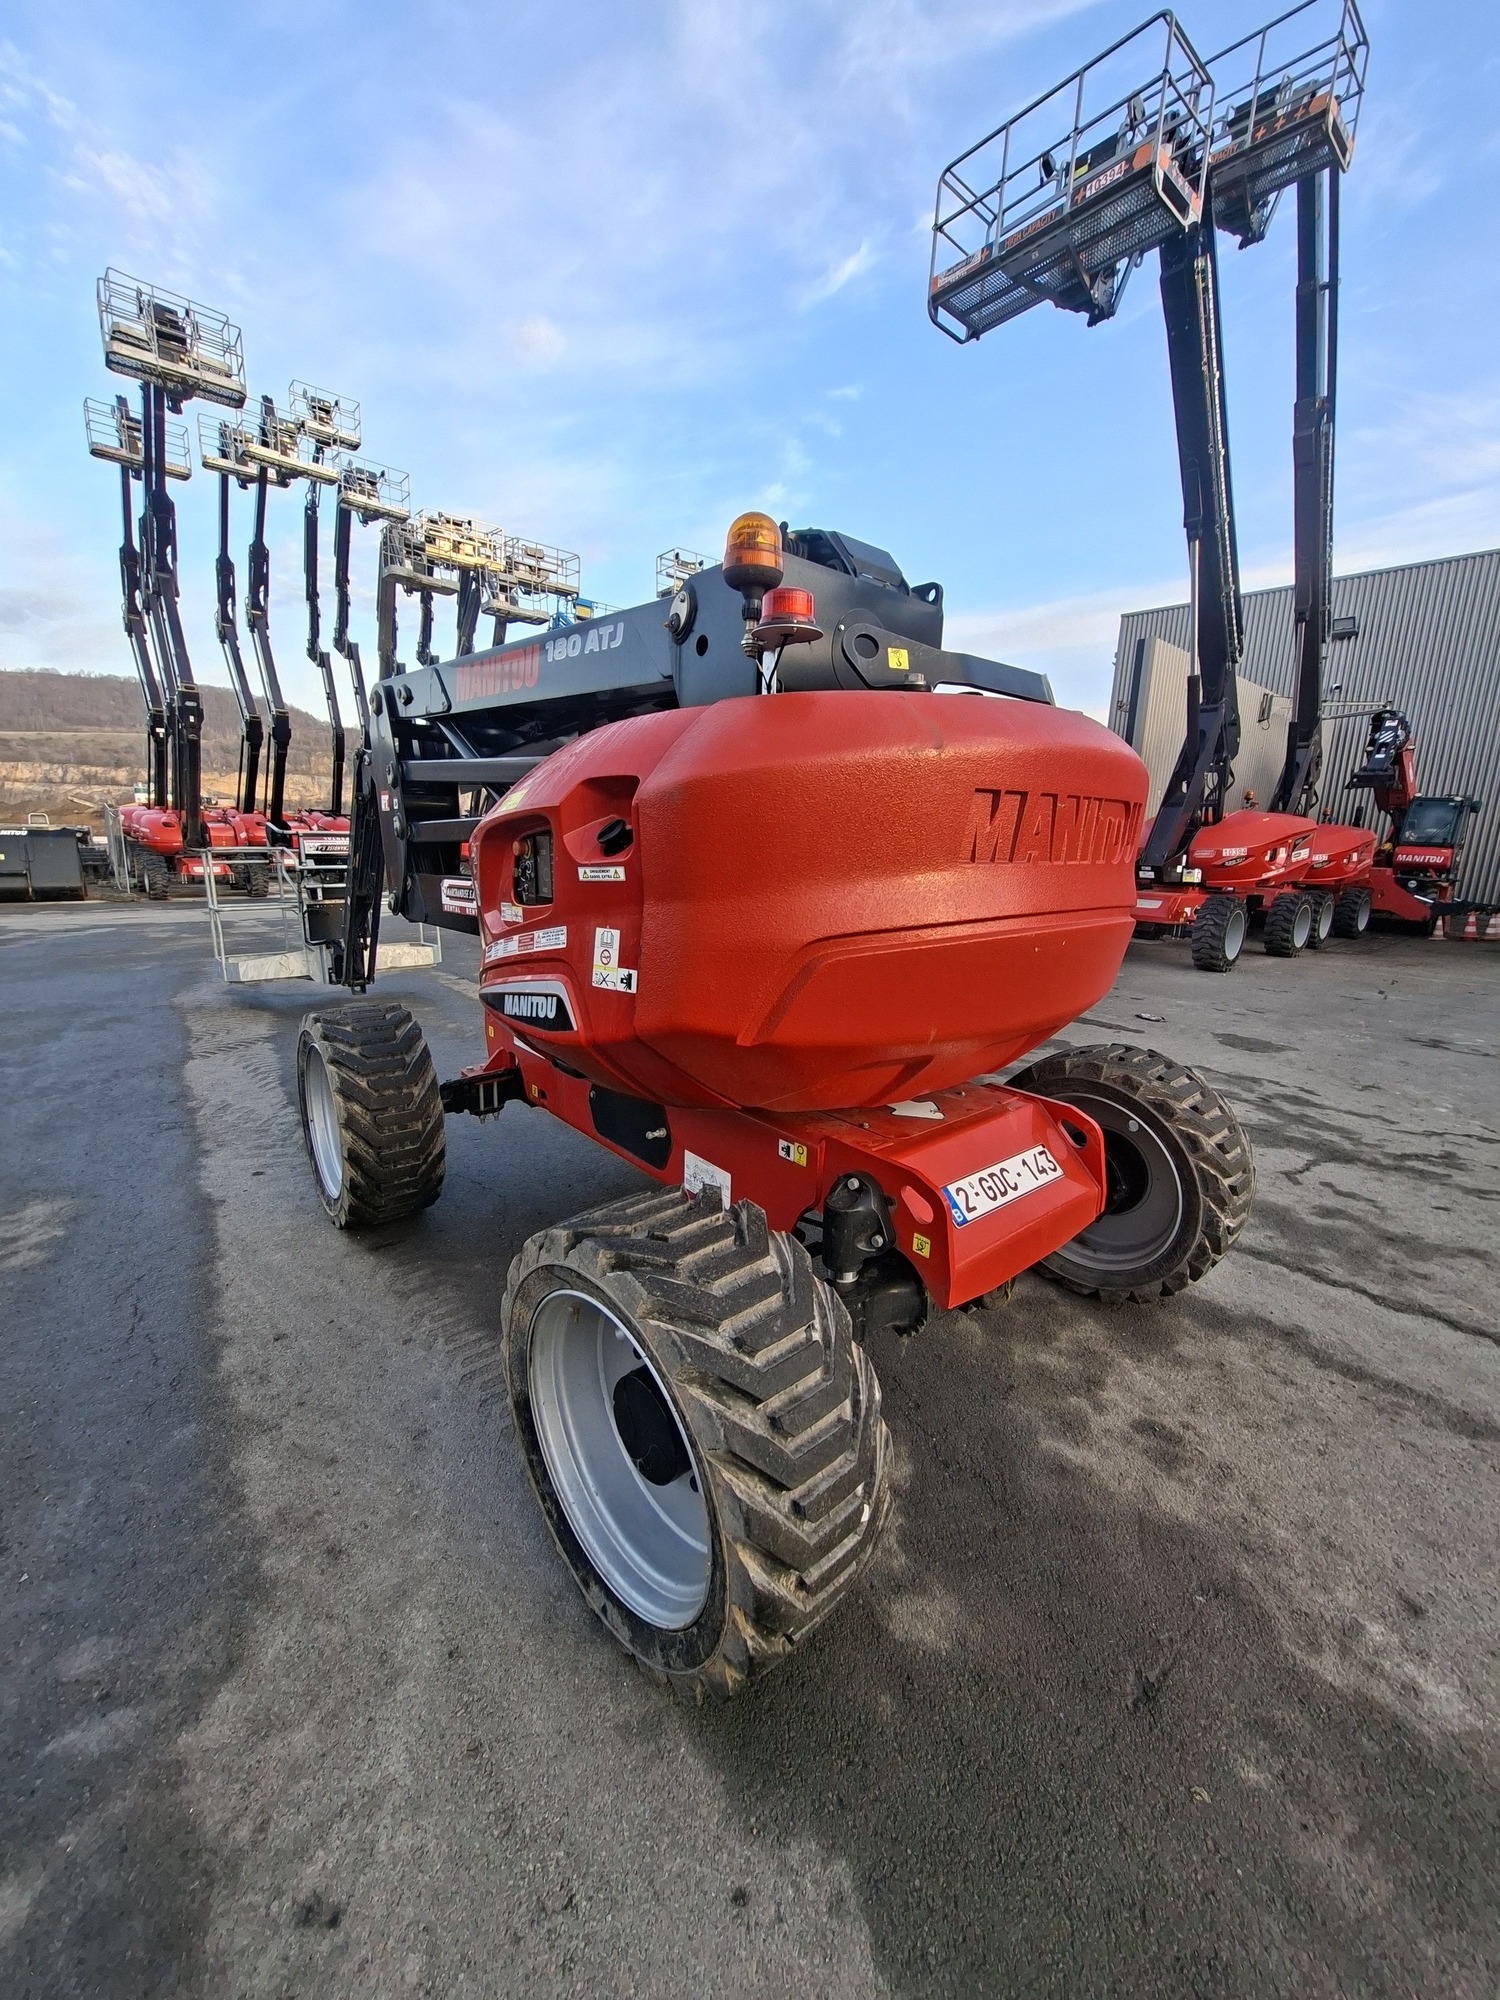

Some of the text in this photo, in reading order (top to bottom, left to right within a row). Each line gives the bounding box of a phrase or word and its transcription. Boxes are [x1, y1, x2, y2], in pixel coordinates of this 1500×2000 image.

[1087, 165, 1125, 195] 10394
[1004, 209, 1057, 249] HIGH CAPACITY
[545, 622, 625, 663] 180 ATJ
[456, 643, 540, 702] MANITOU
[1396, 854, 1445, 863] MANITOU
[504, 994, 558, 1019] MANITOU
[952, 1208, 964, 1222] B
